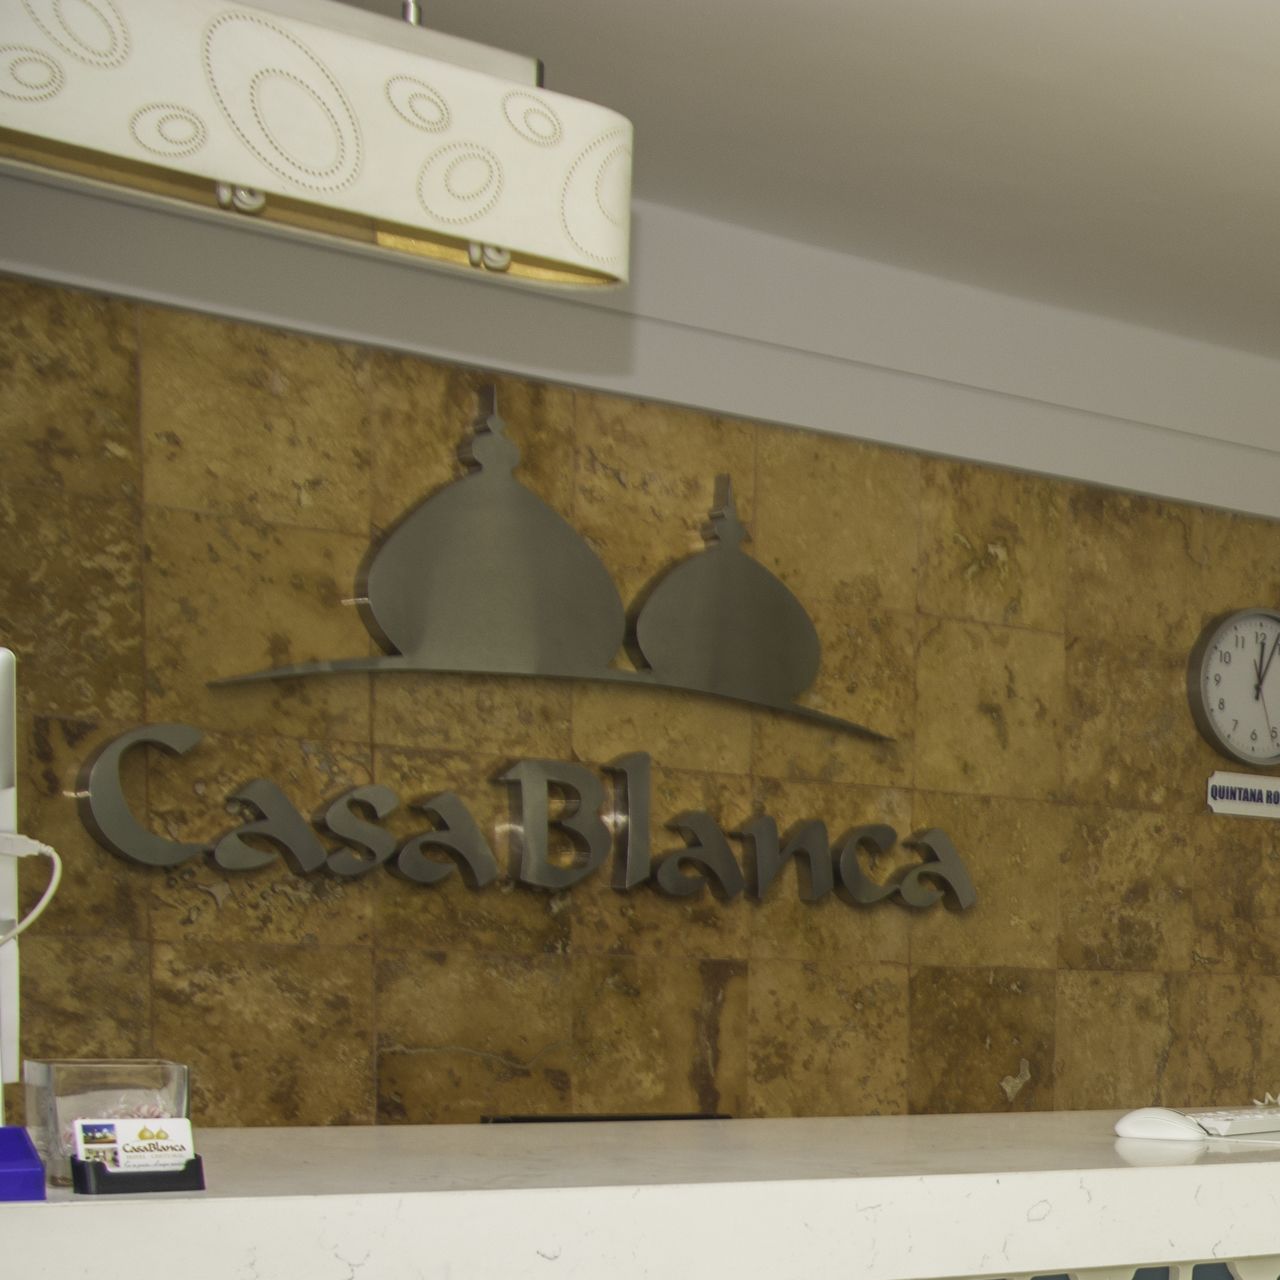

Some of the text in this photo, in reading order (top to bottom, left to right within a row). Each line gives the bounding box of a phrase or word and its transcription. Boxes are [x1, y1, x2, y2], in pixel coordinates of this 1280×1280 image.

[1234, 634, 1246, 650] 11
[1218, 649, 1232, 665] 10
[1214, 672, 1222, 686] 9
[1217, 697, 1225, 711] 8
[1231, 718, 1239, 732] 7
[1250, 728, 1258, 742] 6
[1270, 726, 1278, 740] 5
[1210, 784, 1264, 804] QUINTANA
[76, 724, 977, 911] CasaBlanca
[122, 1141, 187, 1153] CasaBlanca
